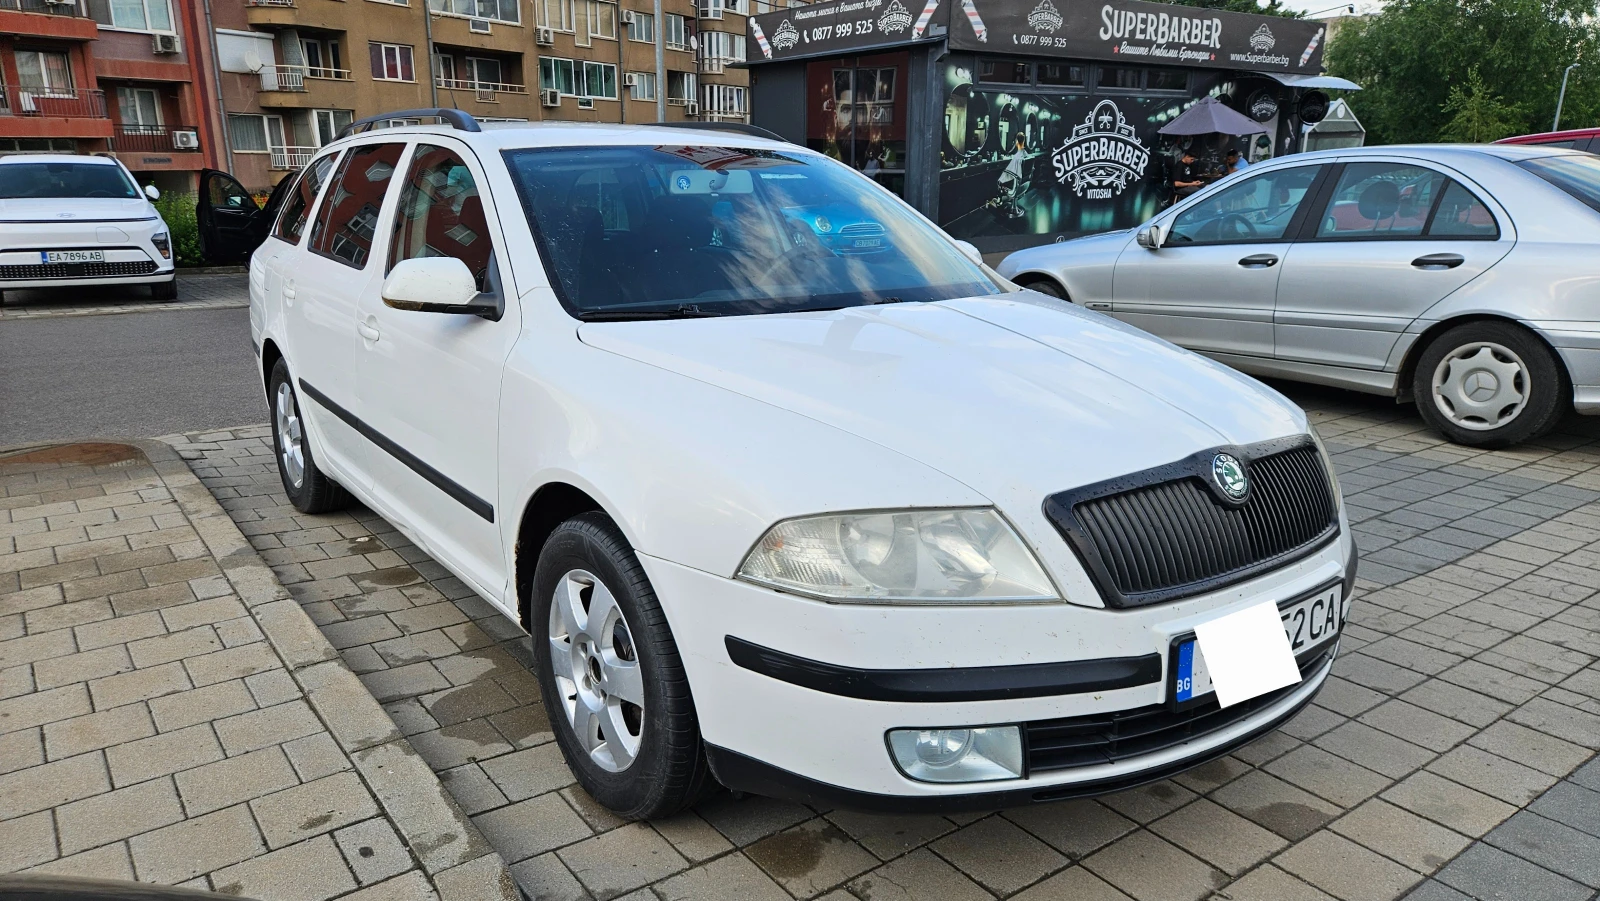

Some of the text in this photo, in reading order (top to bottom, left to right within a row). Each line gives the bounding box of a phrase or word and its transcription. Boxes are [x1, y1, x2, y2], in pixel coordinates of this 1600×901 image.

[812, 19, 873, 41] 0877 999 525
[1020, 34, 1067, 48] 0877 999 525
[1120, 41, 1149, 55] Вашите
[1149, 44, 1179, 58] Любими
[1230, 52, 1289, 67] www.Superbarber.bg
[1087, 189, 1112, 199] VITOSHA
[1177, 677, 1190, 693] BG
